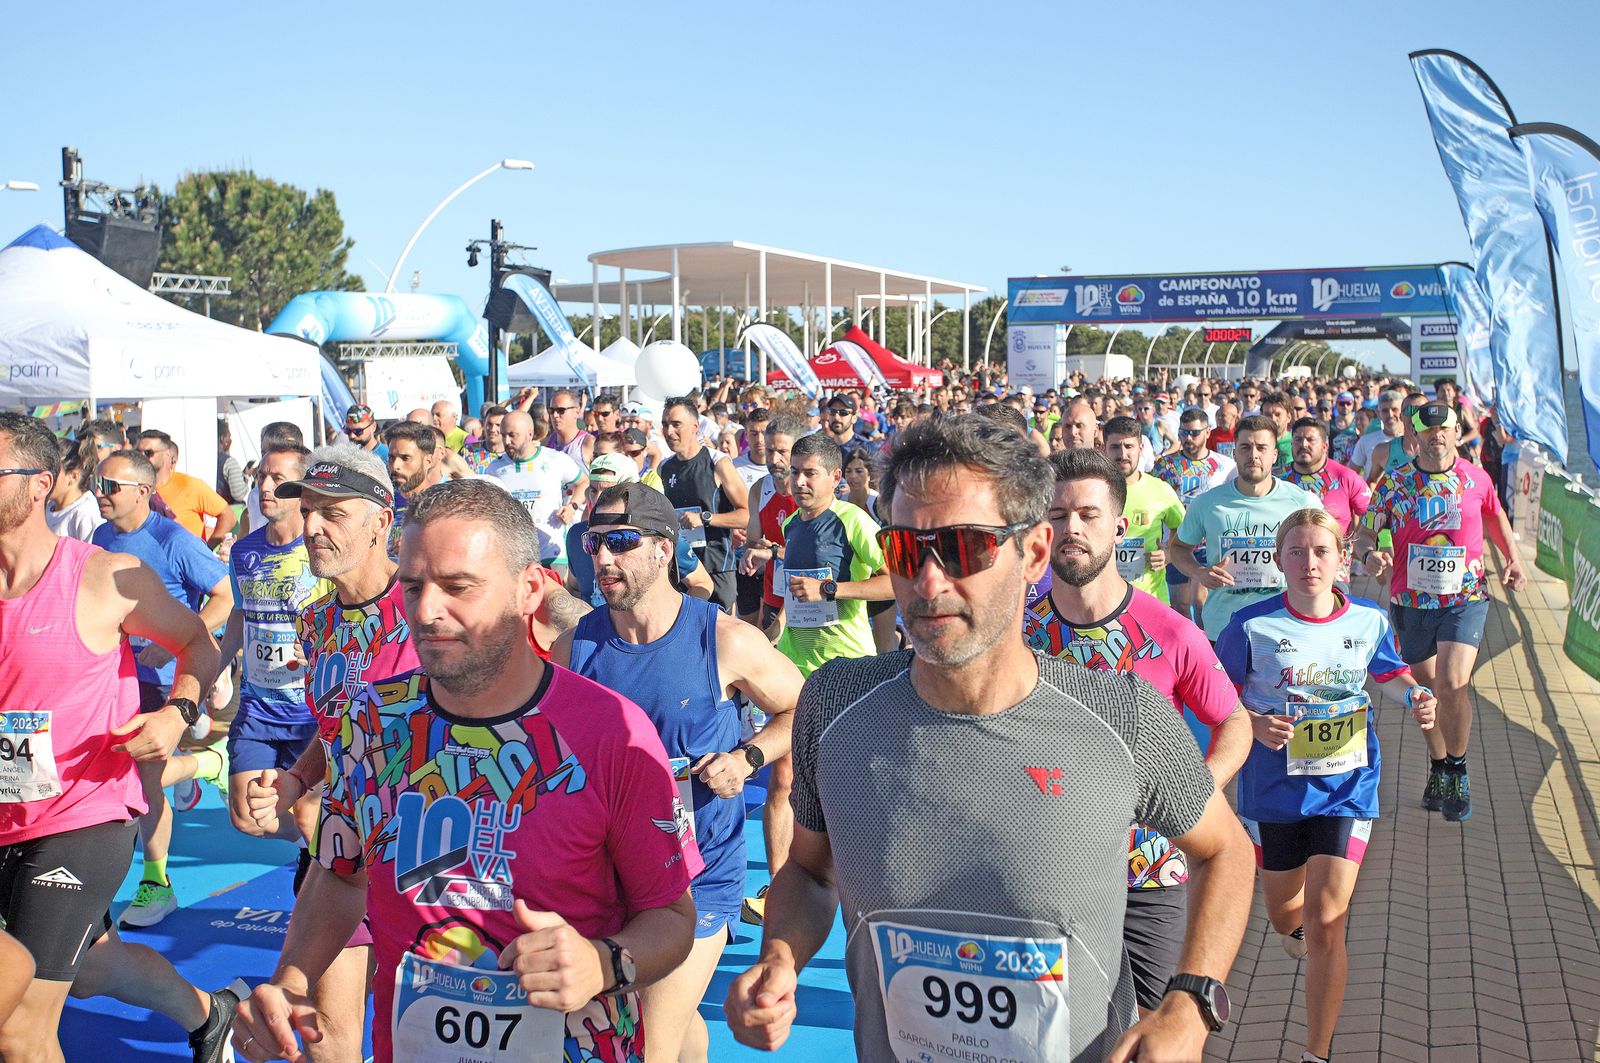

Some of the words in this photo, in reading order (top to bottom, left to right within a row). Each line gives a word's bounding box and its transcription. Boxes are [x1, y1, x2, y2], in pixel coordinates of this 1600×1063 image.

[1159, 276, 1261, 291] CAMPEONATO
[1311, 277, 1338, 311] 10
[1338, 282, 1381, 297] HUELVA
[1418, 283, 1449, 296] WiH
[1075, 285, 1099, 316] 10
[1158, 295, 1174, 306] de
[1178, 292, 1229, 306] ESPAÑA
[1237, 290, 1260, 306] 10
[1266, 288, 1297, 305] km
[1207, 307, 1223, 315] ruta
[1225, 306, 1260, 315] Absoluto
[1269, 306, 1297, 314] Master
[1416, 495, 1446, 529] 10
[1230, 550, 1272, 564] 1479
[1418, 558, 1456, 572] 1299
[277, 633, 296, 642] 2023
[256, 643, 284, 662] 621
[1274, 663, 1366, 689] Atletism
[12, 718, 39, 730] 2023
[1303, 717, 1354, 743] 1871
[474, 798, 523, 833] HU
[394, 792, 474, 906] 10
[470, 825, 518, 860] EL
[470, 852, 514, 884] VA
[31, 880, 53, 888] NIKE
[56, 883, 82, 891] TRAIL
[887, 929, 911, 964] 10
[911, 939, 952, 959] HUELVA
[960, 961, 982, 973] WiHu
[995, 949, 1046, 974] 2023
[413, 961, 433, 993] 10
[433, 971, 467, 991] HUELVA
[473, 993, 493, 1003] WiHu
[505, 982, 528, 1000] 20
[922, 975, 1017, 1030] 999
[435, 1005, 523, 1051] 607
[951, 1032, 989, 1049] PABLO
[898, 1029, 935, 1049] GARCÍA
[936, 1044, 997, 1063] IZQUIERDO
